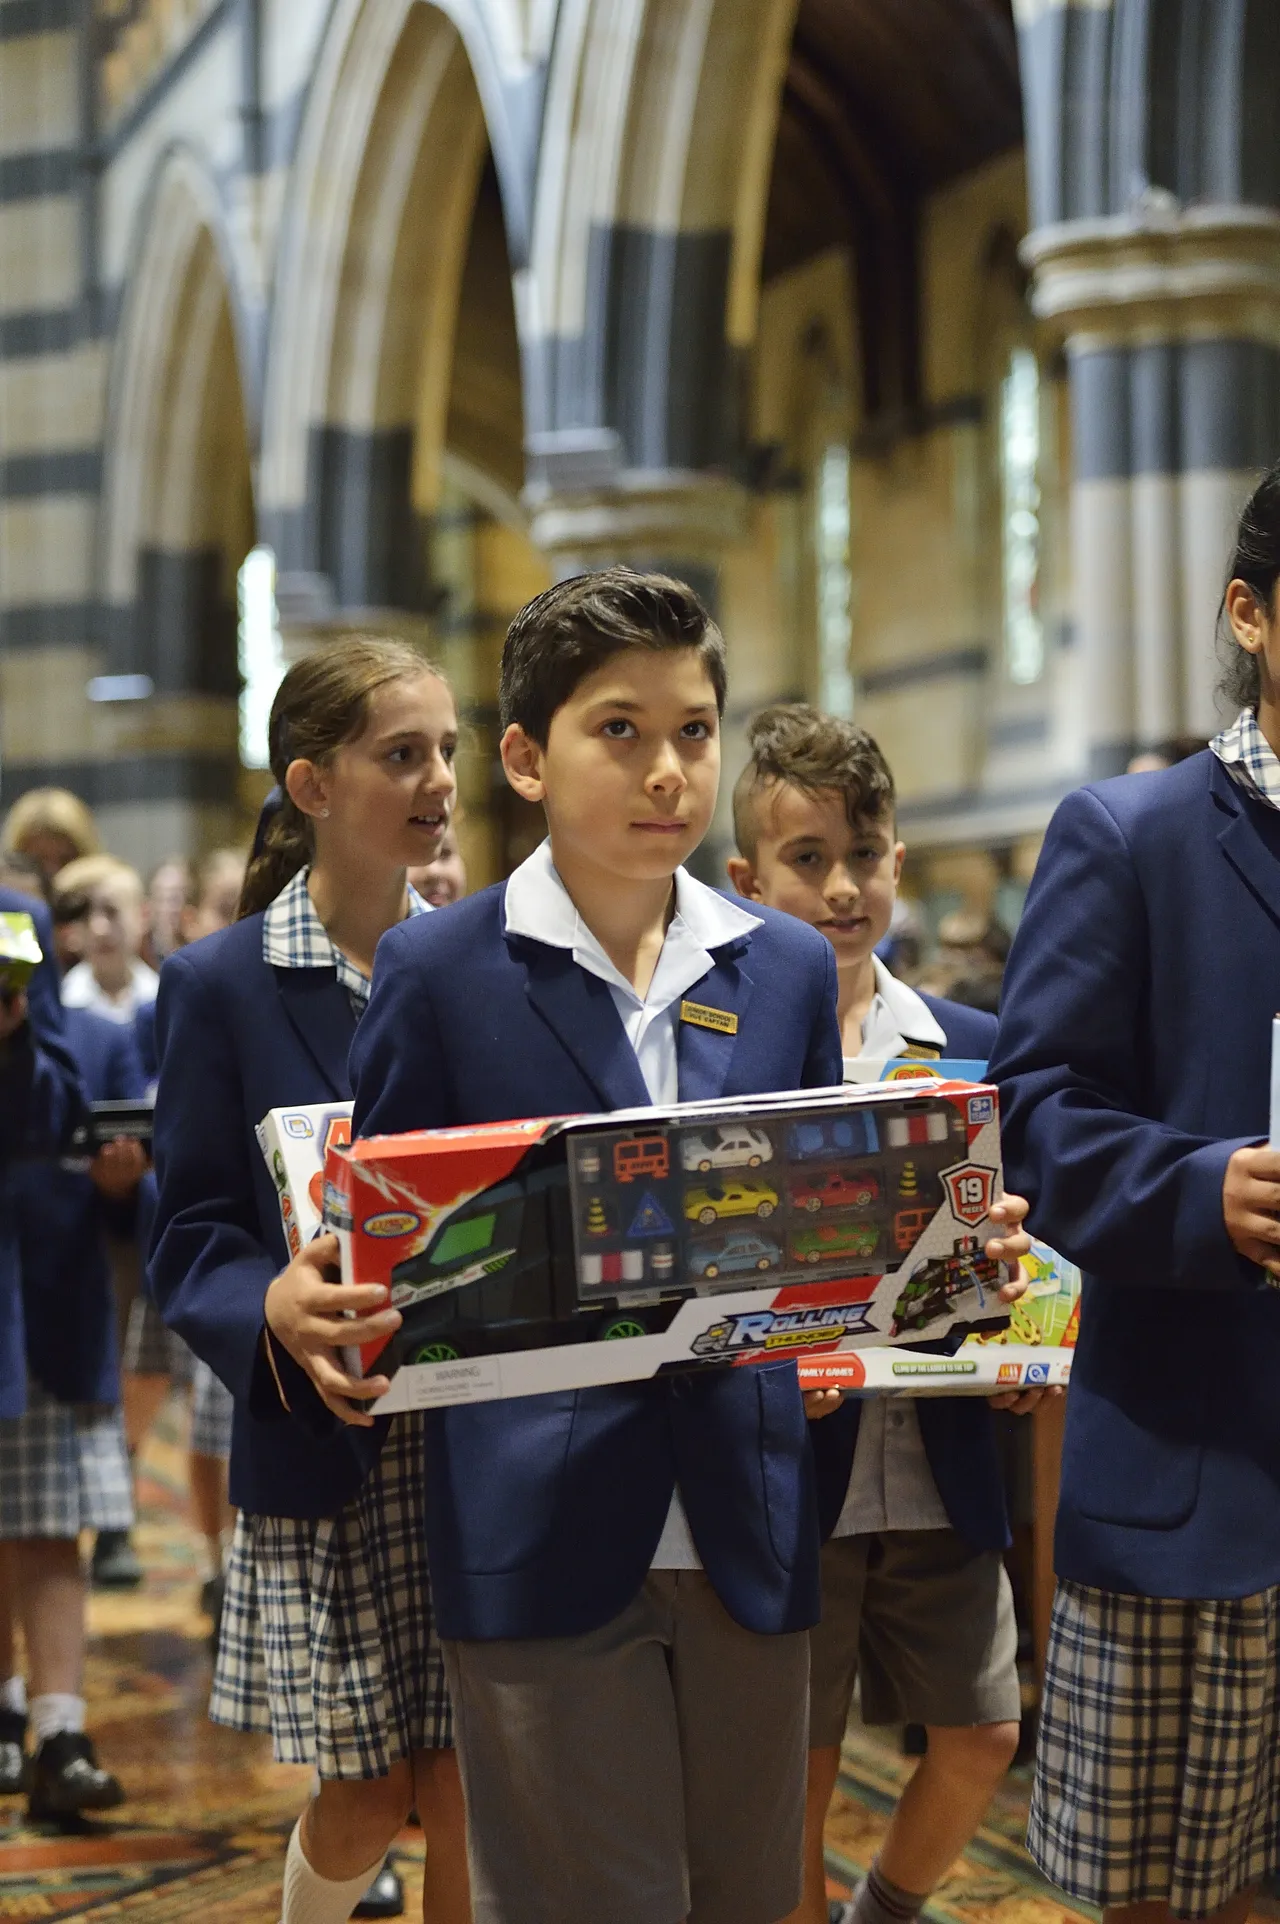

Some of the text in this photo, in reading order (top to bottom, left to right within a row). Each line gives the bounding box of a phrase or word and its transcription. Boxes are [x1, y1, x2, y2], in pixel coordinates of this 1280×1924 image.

[704, 1017, 730, 1027] CAPTAIN
[708, 1011, 732, 1022] SCHOOL
[972, 1100, 989, 1112] 3+
[957, 1177, 983, 1204] 19
[961, 1206, 984, 1214] PIECES
[728, 1305, 866, 1346] ROLLING
[435, 1365, 481, 1382] WARNING
[825, 1367, 854, 1377] GAMES
